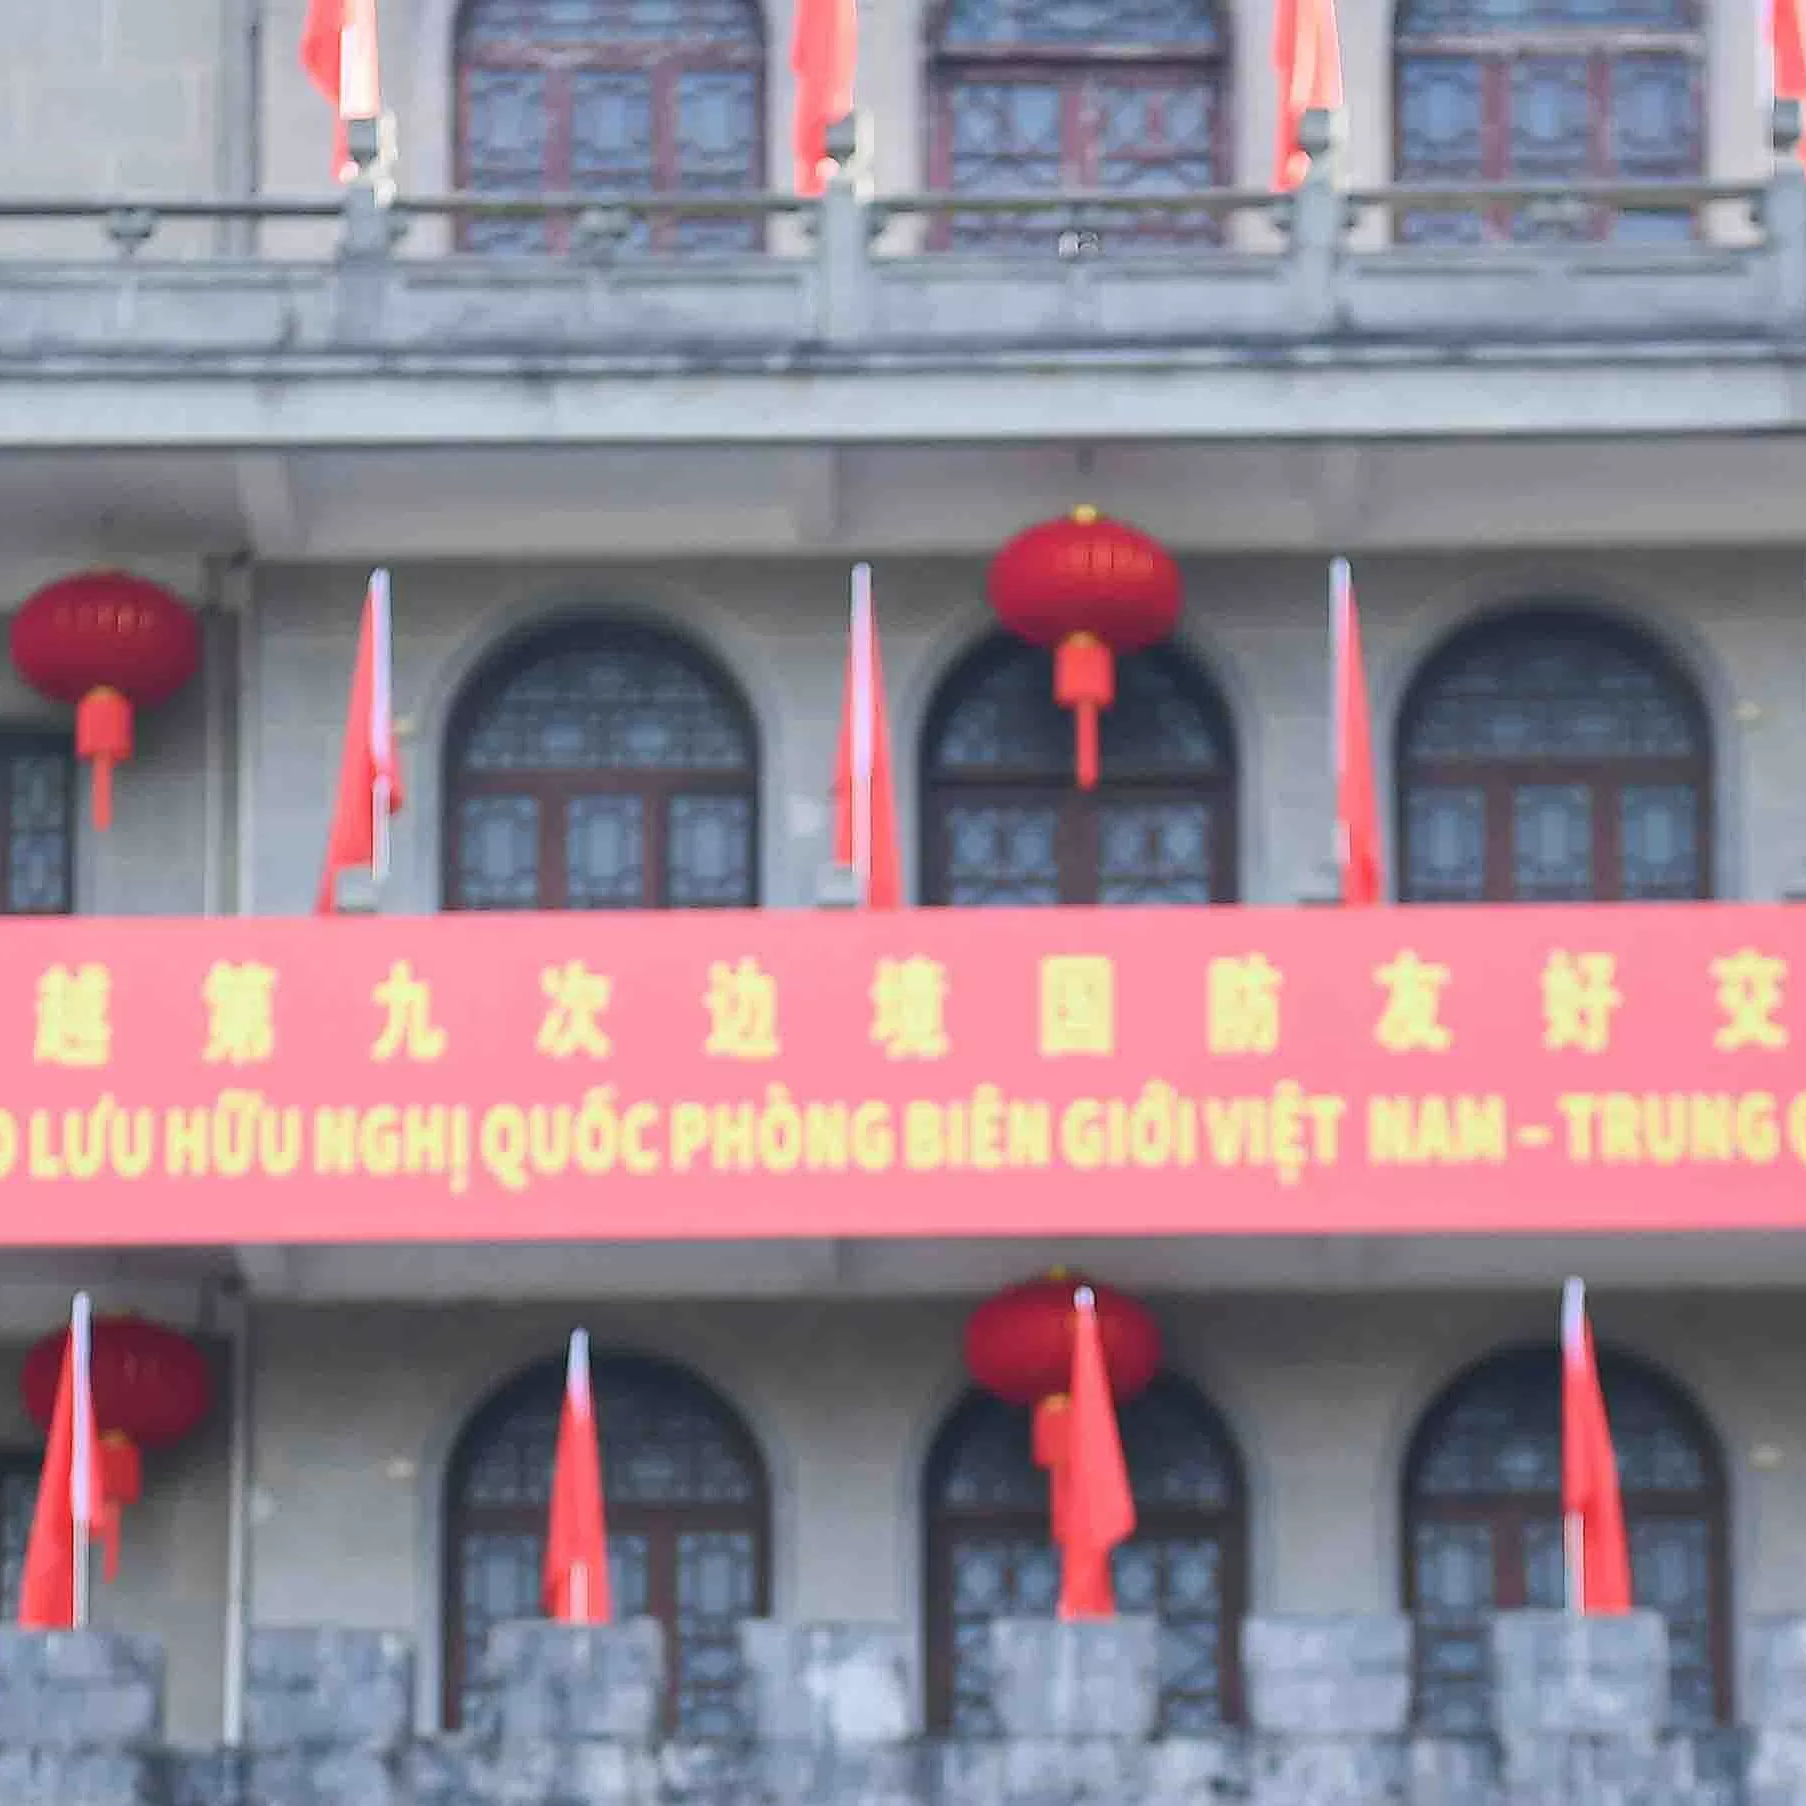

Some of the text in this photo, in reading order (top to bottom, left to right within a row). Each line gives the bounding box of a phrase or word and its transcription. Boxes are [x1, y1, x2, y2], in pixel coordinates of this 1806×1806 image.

[28, 1092, 155, 1180] LƯU
[164, 1086, 304, 1178] HỮU
[312, 1102, 472, 1195] NGHỊ
[479, 1085, 662, 1191] QUỐC
[668, 1081, 896, 1174] PHÒNG
[902, 1082, 1053, 1172] BIÊN
[1059, 1078, 1198, 1170] GIỚI
[1203, 1078, 1348, 1186] VIỆT
[1367, 1094, 1508, 1165] NAM
[1556, 1090, 1781, 1165] TRUNG
